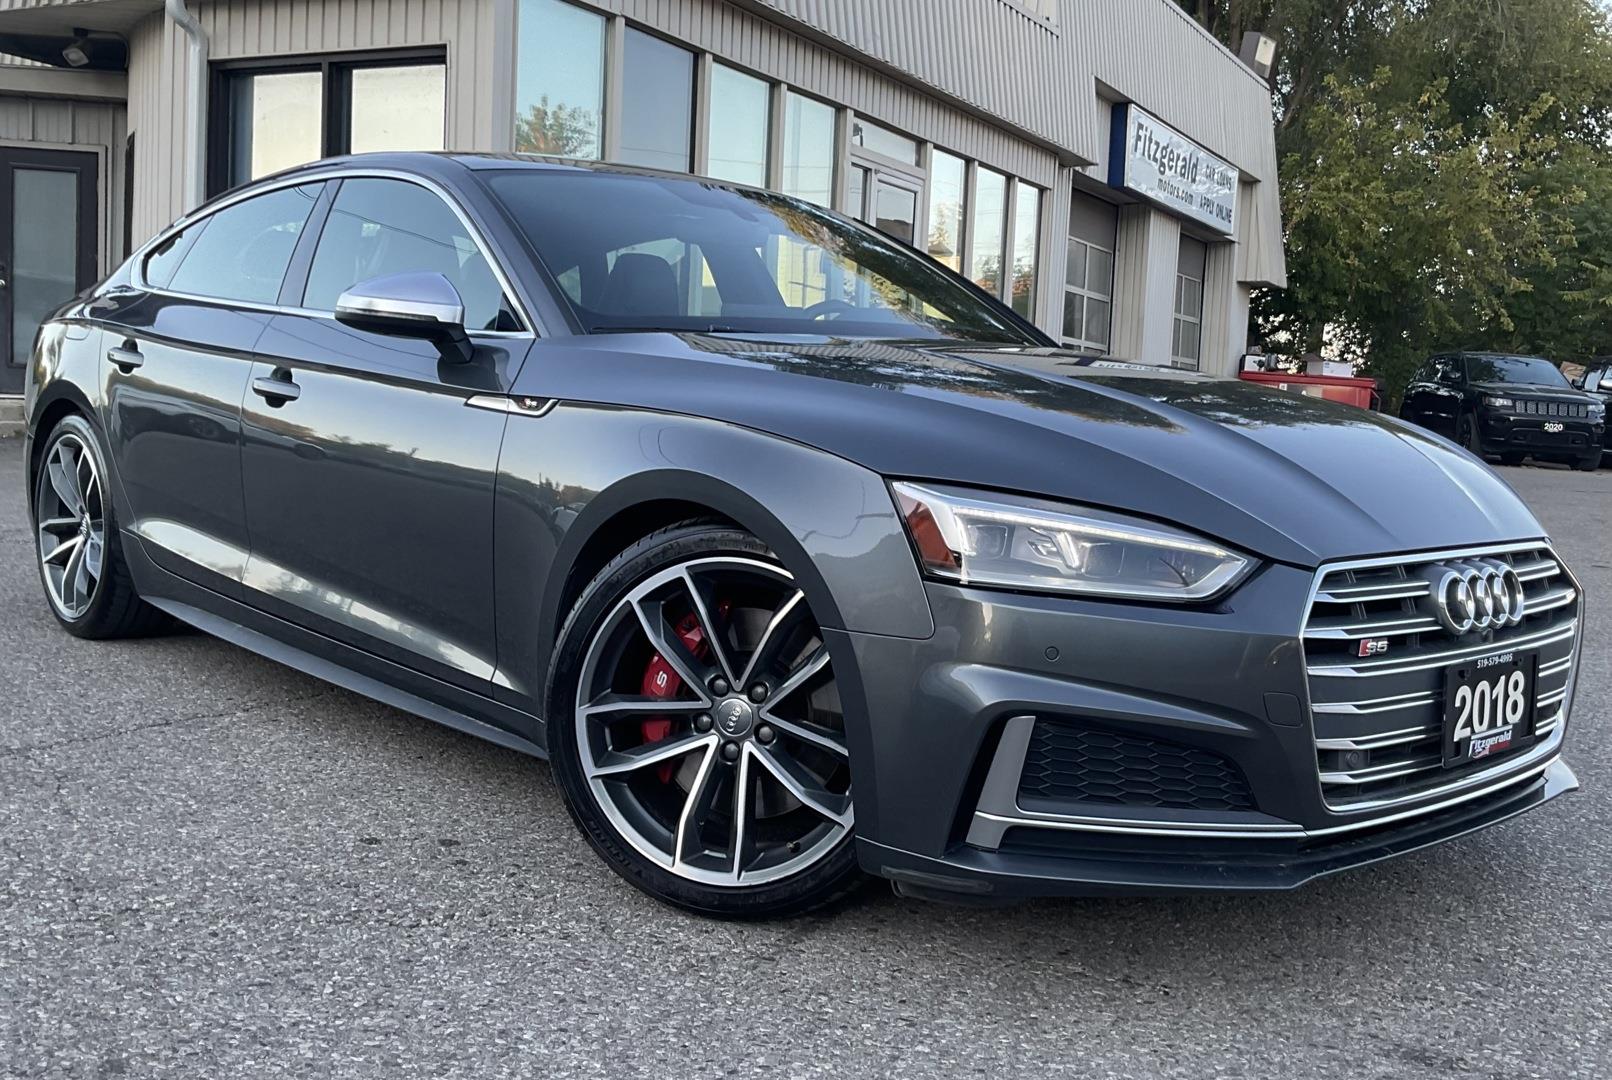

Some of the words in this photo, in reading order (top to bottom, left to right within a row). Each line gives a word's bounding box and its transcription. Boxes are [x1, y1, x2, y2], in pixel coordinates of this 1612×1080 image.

[1134, 121, 1199, 185] Fitzgerald
[1157, 178, 1194, 206] motors.com
[1199, 195, 1215, 215] APPLY
[1215, 203, 1232, 224] ONLINE
[1544, 422, 1563, 431] 2020
[1365, 640, 1389, 653] S5
[1453, 670, 1525, 742] 2018
